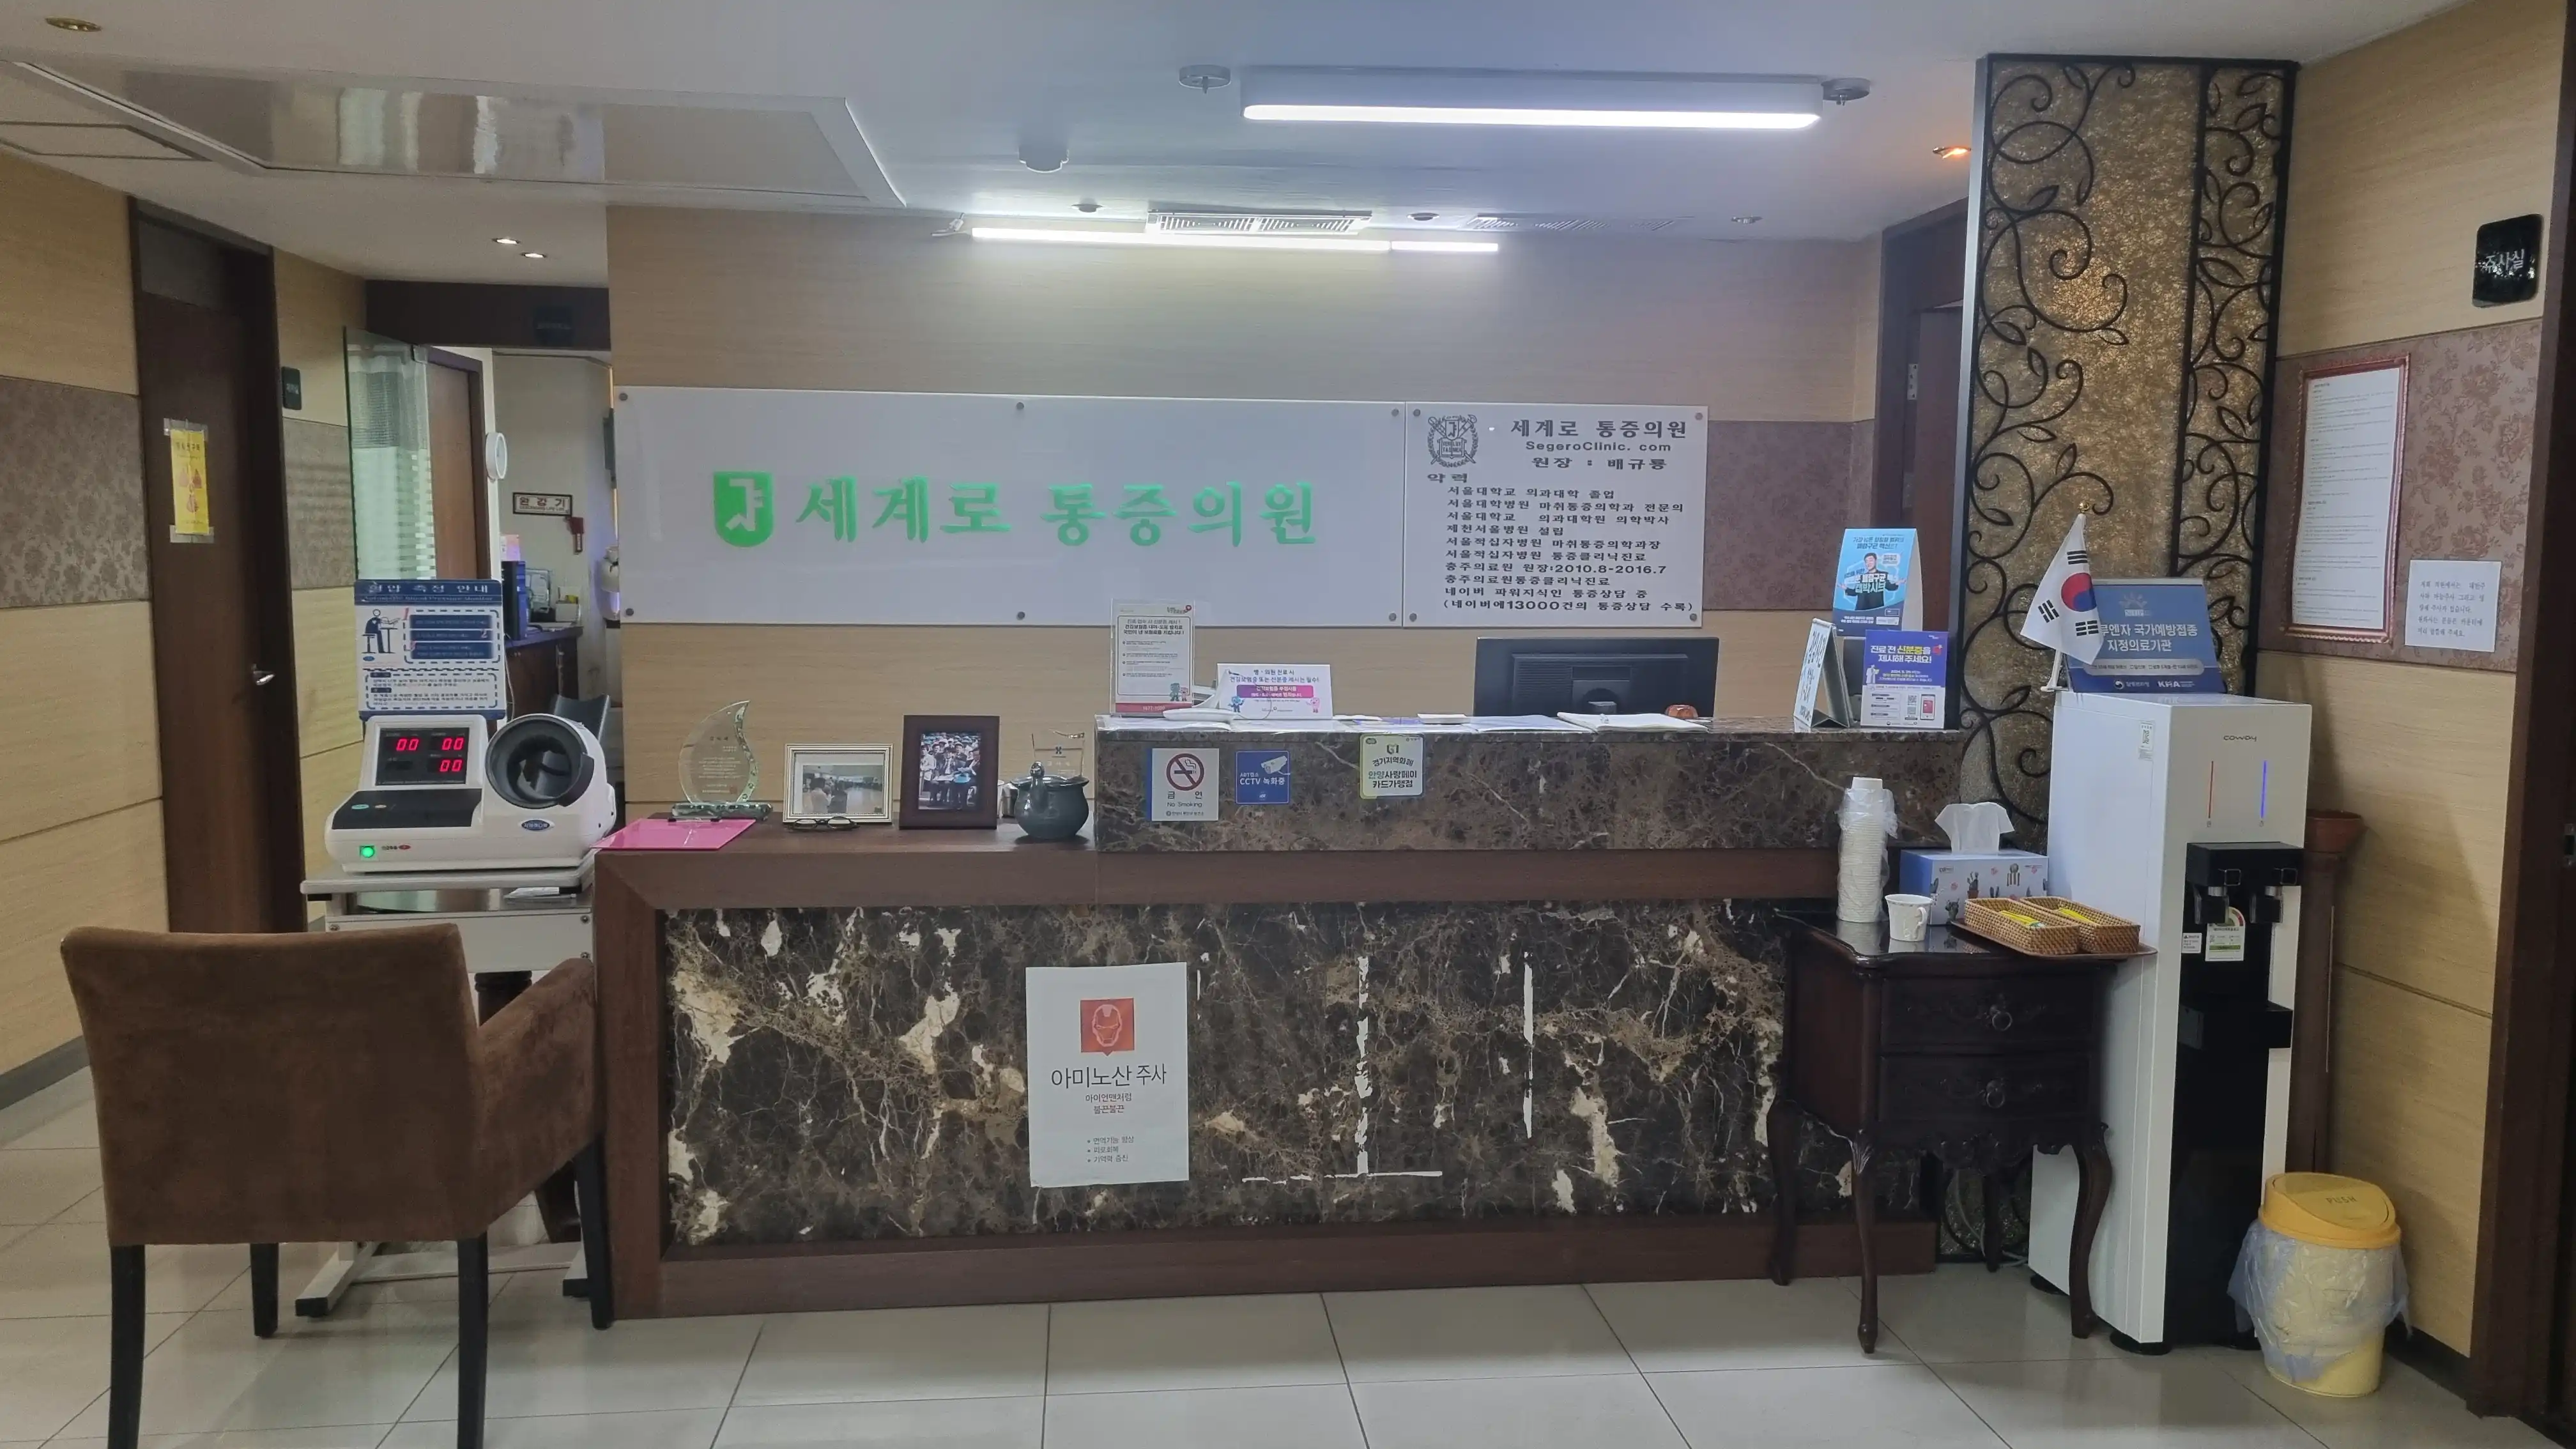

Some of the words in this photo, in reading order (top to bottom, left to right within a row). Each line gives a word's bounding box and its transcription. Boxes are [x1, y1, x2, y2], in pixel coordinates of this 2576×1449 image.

[2486, 249, 2524, 273] 주사실
[1511, 420, 1579, 437] 세계로
[1596, 421, 1686, 438] 통증의원
[1531, 457, 1572, 468] 원장
[1448, 486, 1516, 496] 서울대학교
[1526, 487, 1579, 499] 의과대학
[1588, 489, 1614, 499] 졸업
[795, 475, 1011, 543] 세계로
[1039, 480, 1316, 547] 통증의원
[1447, 498, 1529, 510] 서울대학병원
[1540, 502, 1635, 512] 마취통증의학과
[1644, 503, 1683, 512] 전문의
[1446, 511, 1516, 522] 서울대학교
[1538, 514, 1606, 525] 의과대학원
[1616, 516, 1669, 525] 의학박사
[1446, 524, 1529, 535] 제천서울병원
[1538, 527, 1563, 536] 설립
[1446, 537, 1542, 548] 서울적십자병원
[1552, 539, 1661, 550] 마취통증의학과장
[1445, 549, 1542, 560] 서울적십자병원
[1551, 551, 1646, 562] 통증클리닉진료
[1445, 562, 1514, 572] 충주의료원
[457, 584, 489, 594] 안내
[1445, 586, 1484, 597] 네이버
[1494, 588, 1562, 598] 파워지식인
[1572, 589, 1626, 599] 통증상담
[1636, 590, 1648, 599] 중
[1597, 602, 1652, 611] 통증상담
[1660, 602, 1693, 611] 수록)
[2100, 624, 2131, 636] 루엔자
[2134, 624, 2198, 637] 국가예방접종
[1871, 645, 1887, 654] 진료
[1887, 645, 1896, 654] 전
[1897, 645, 1931, 655] 신분증을
[2107, 640, 2172, 652] 지정의료기관
[1878, 654, 1904, 663] 제시해
[1905, 655, 1932, 664] 주세요!
[396, 739, 419, 751] 00
[441, 737, 464, 750] 00
[440, 760, 463, 772] 00
[1372, 756, 1414, 767] 경기지역화폐
[1368, 770, 1417, 779] 안양사랑페이
[1263, 777, 1285, 786] 녹화중
[1373, 779, 1413, 788] 카드가맹점
[1051, 1064, 1132, 1089] 아미노산
[1136, 1062, 1167, 1086] 주사
[1085, 1092, 1132, 1103] 아이언맨처럼
[1094, 1154, 1113, 1163] 기억력
[2325, 1195, 2358, 1205] PUSH
